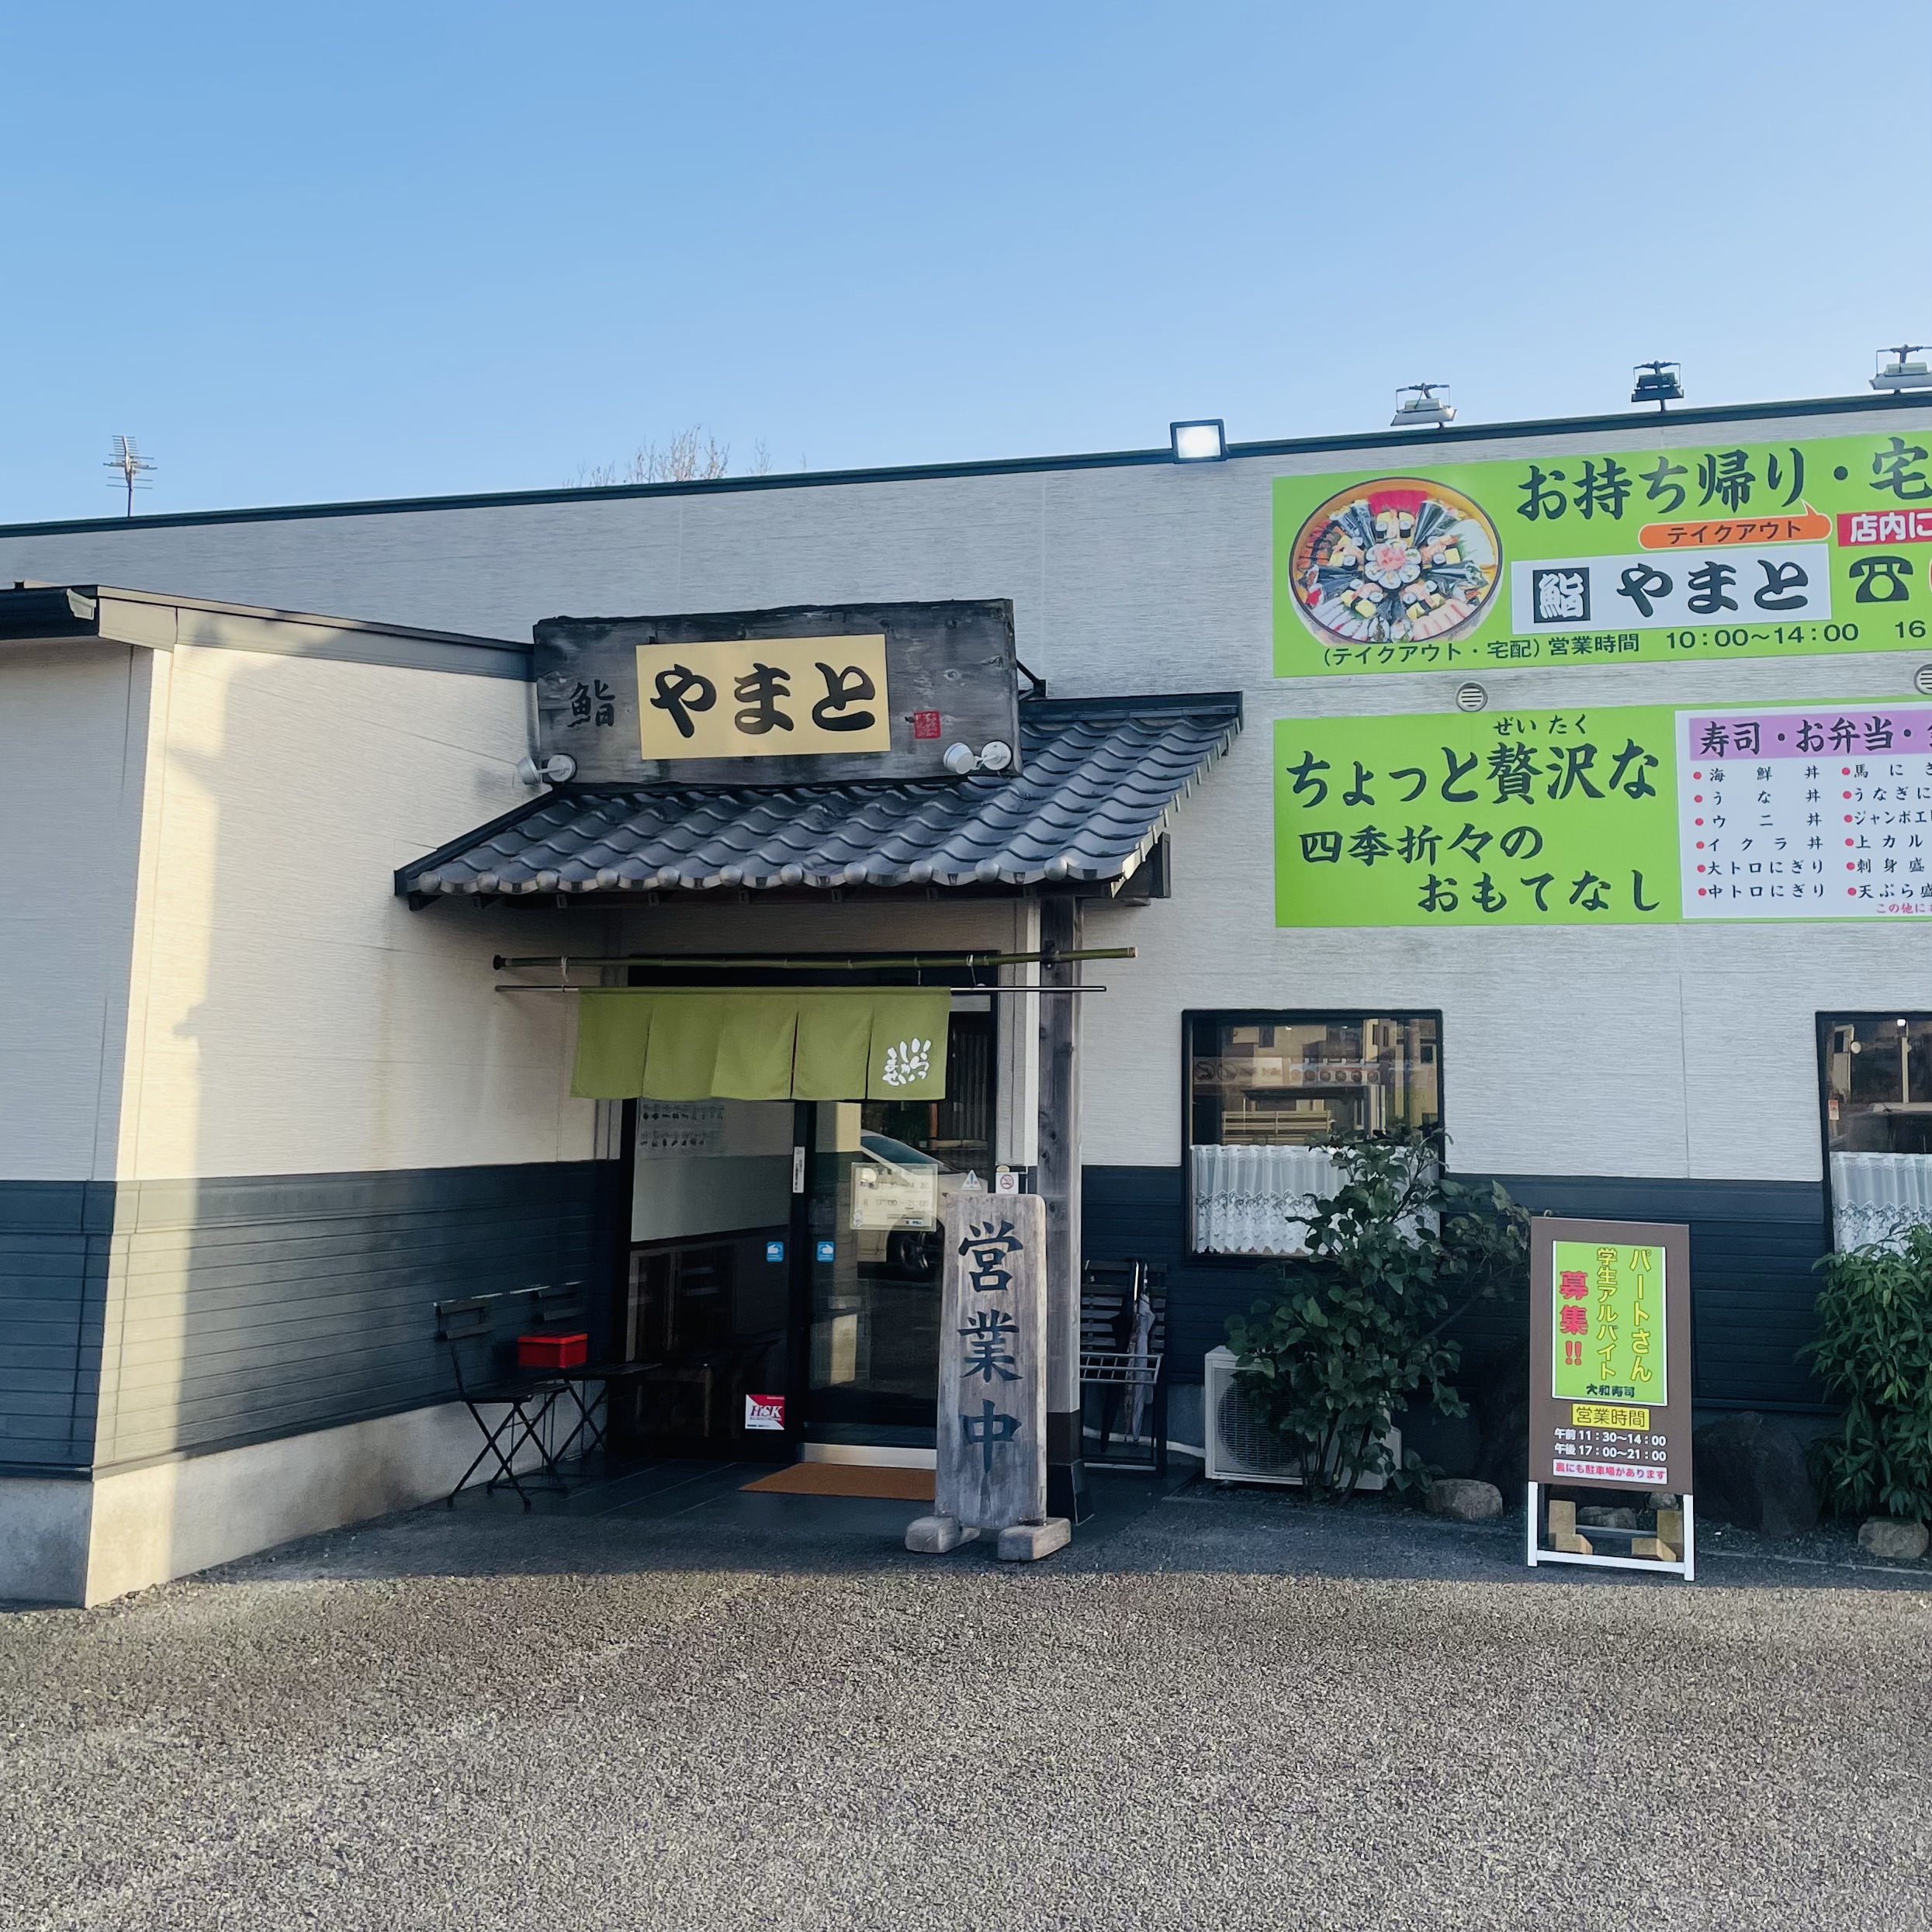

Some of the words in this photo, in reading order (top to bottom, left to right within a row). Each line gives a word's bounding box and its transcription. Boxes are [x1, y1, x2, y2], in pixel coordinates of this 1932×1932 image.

[1667, 521, 1802, 545] テイクアウト
[1851, 511, 1932, 543] 店内に
[1537, 572, 1585, 619] 鮨
[1617, 559, 1809, 618] やまと
[568, 679, 615, 728] 鮨
[650, 663, 876, 739] やまと
[1699, 715, 1932, 758] 寿司・お弁当・
[1286, 738, 1660, 808] ちょっと贅沢な
[1854, 810, 1932, 825] ジャンボエ
[1300, 823, 1542, 867] 四季折々の
[1707, 859, 1823, 875] 大トロにぎり
[1418, 870, 1660, 913] おもてなし
[1709, 883, 1824, 899] 中トロにぎり
[1876, 902, 1932, 914] この他に
[1596, 1247, 1619, 1380] 学生アルバイト
[1629, 1248, 1653, 1383] パートさん
[957, 1220, 1024, 1477] 営業中
[750, 1405, 784, 1418] HSK
[1576, 1407, 1645, 1427] 営業時間
